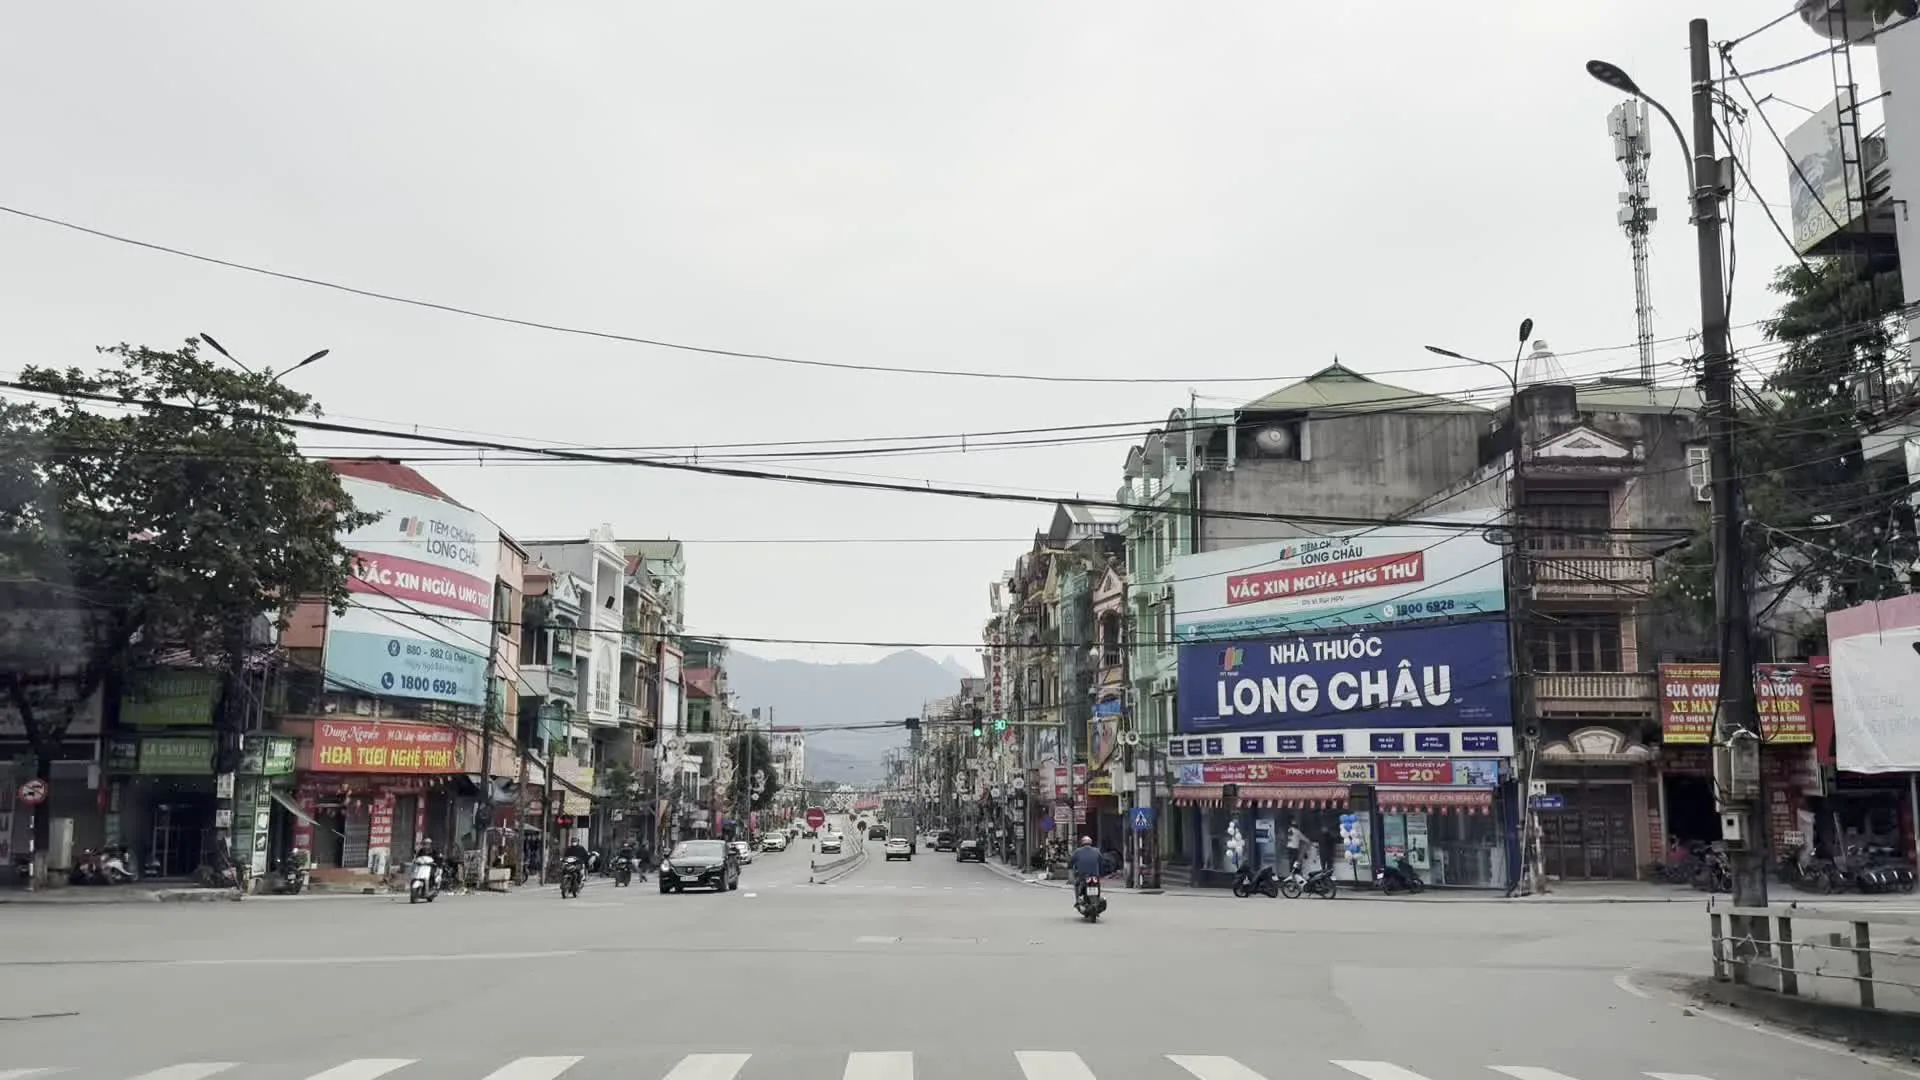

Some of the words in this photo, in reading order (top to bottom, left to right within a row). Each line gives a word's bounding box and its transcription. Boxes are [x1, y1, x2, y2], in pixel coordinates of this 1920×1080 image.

[427, 538, 457, 558] LONG
[1300, 549, 1330, 564] LONG
[1332, 545, 1363, 561] CHÂU
[353, 560, 392, 586] VẮC
[393, 572, 420, 591] XIN
[421, 574, 457, 600] NGỪA
[458, 586, 478, 602] UNG
[1230, 578, 1260, 599] VẮC
[1262, 578, 1290, 595] XIN
[1293, 570, 1338, 592] NGỪA
[1343, 568, 1377, 584] UNG
[1380, 558, 1419, 581] THƯ
[1396, 603, 1423, 616] 1800
[1426, 599, 1455, 613] 6928
[1270, 637, 1309, 665] NHÀ
[1312, 628, 1383, 661] THUỐC
[400, 675, 430, 692] 1800
[432, 679, 457, 696] 6928
[1217, 674, 1319, 716] LONG
[1328, 659, 1451, 711] CHÂU
[1666, 681, 1689, 697] SỬA
[1673, 700, 1688, 713] XE
[320, 745, 352, 765] HOA
[357, 745, 388, 766] TƯƠI
[390, 746, 421, 769] NGHỆ
